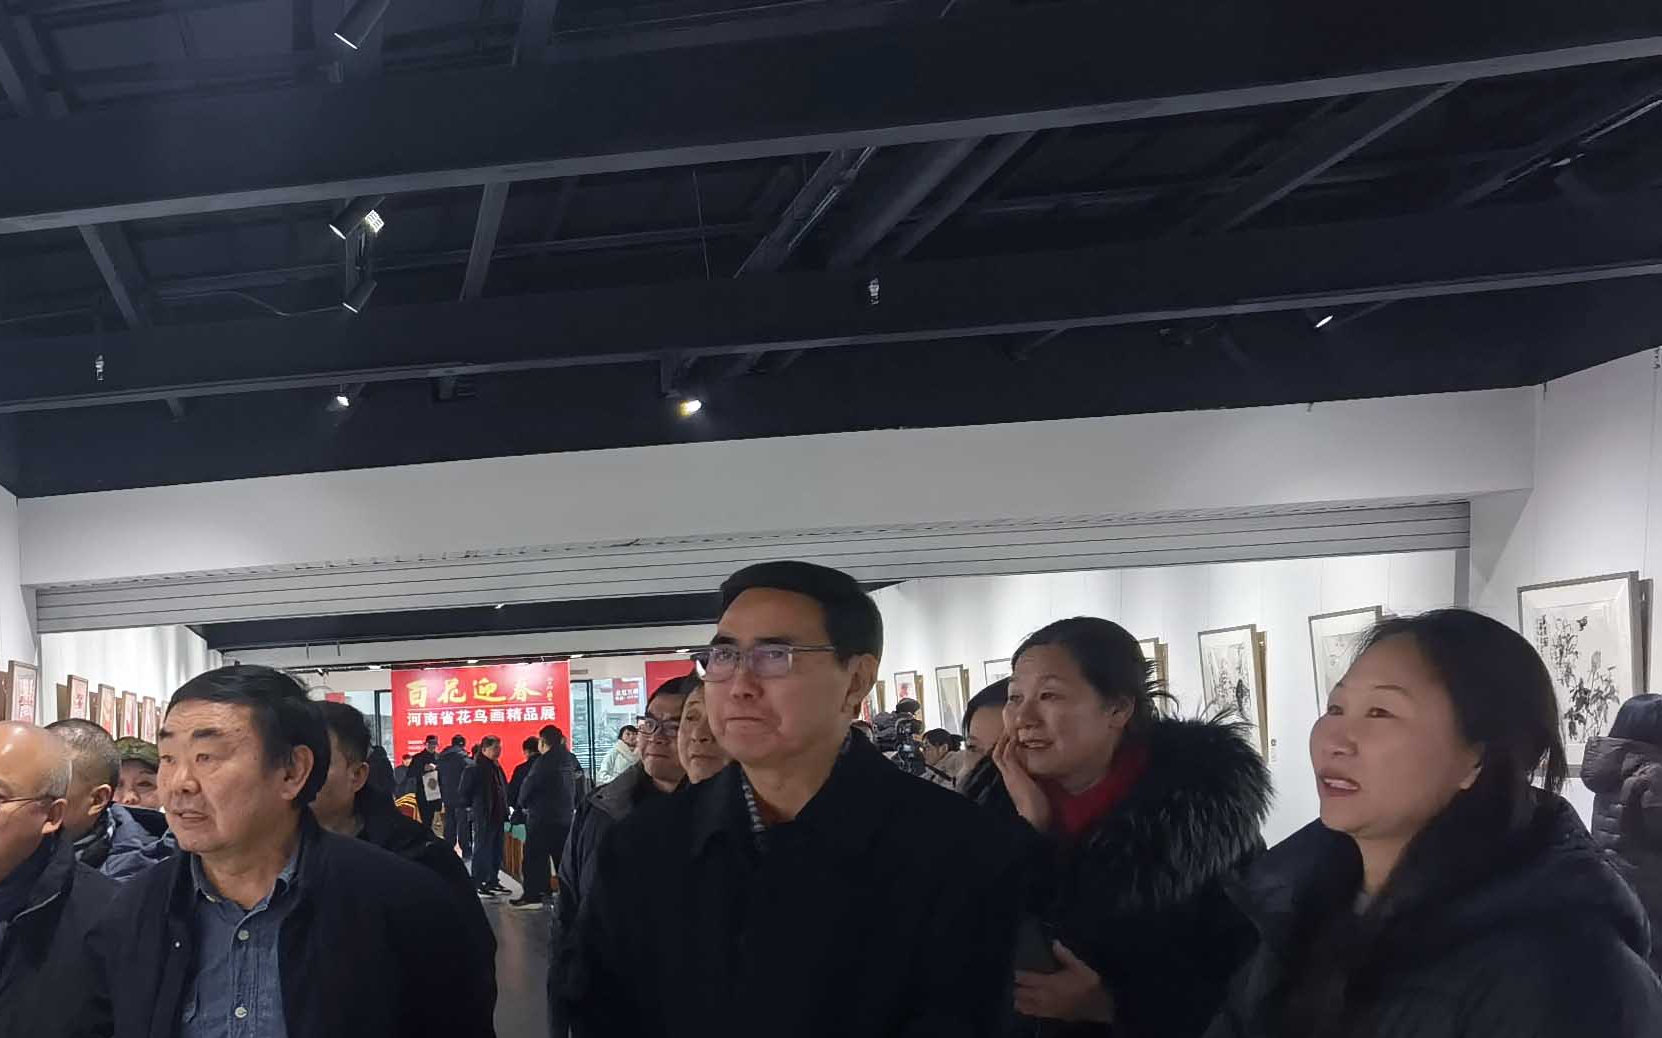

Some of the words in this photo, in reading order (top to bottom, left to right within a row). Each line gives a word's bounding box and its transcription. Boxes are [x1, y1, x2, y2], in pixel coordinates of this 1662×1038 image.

[405, 677, 542, 708] 百花迎春
[407, 706, 556, 727] 河南省花鸟画精品展
